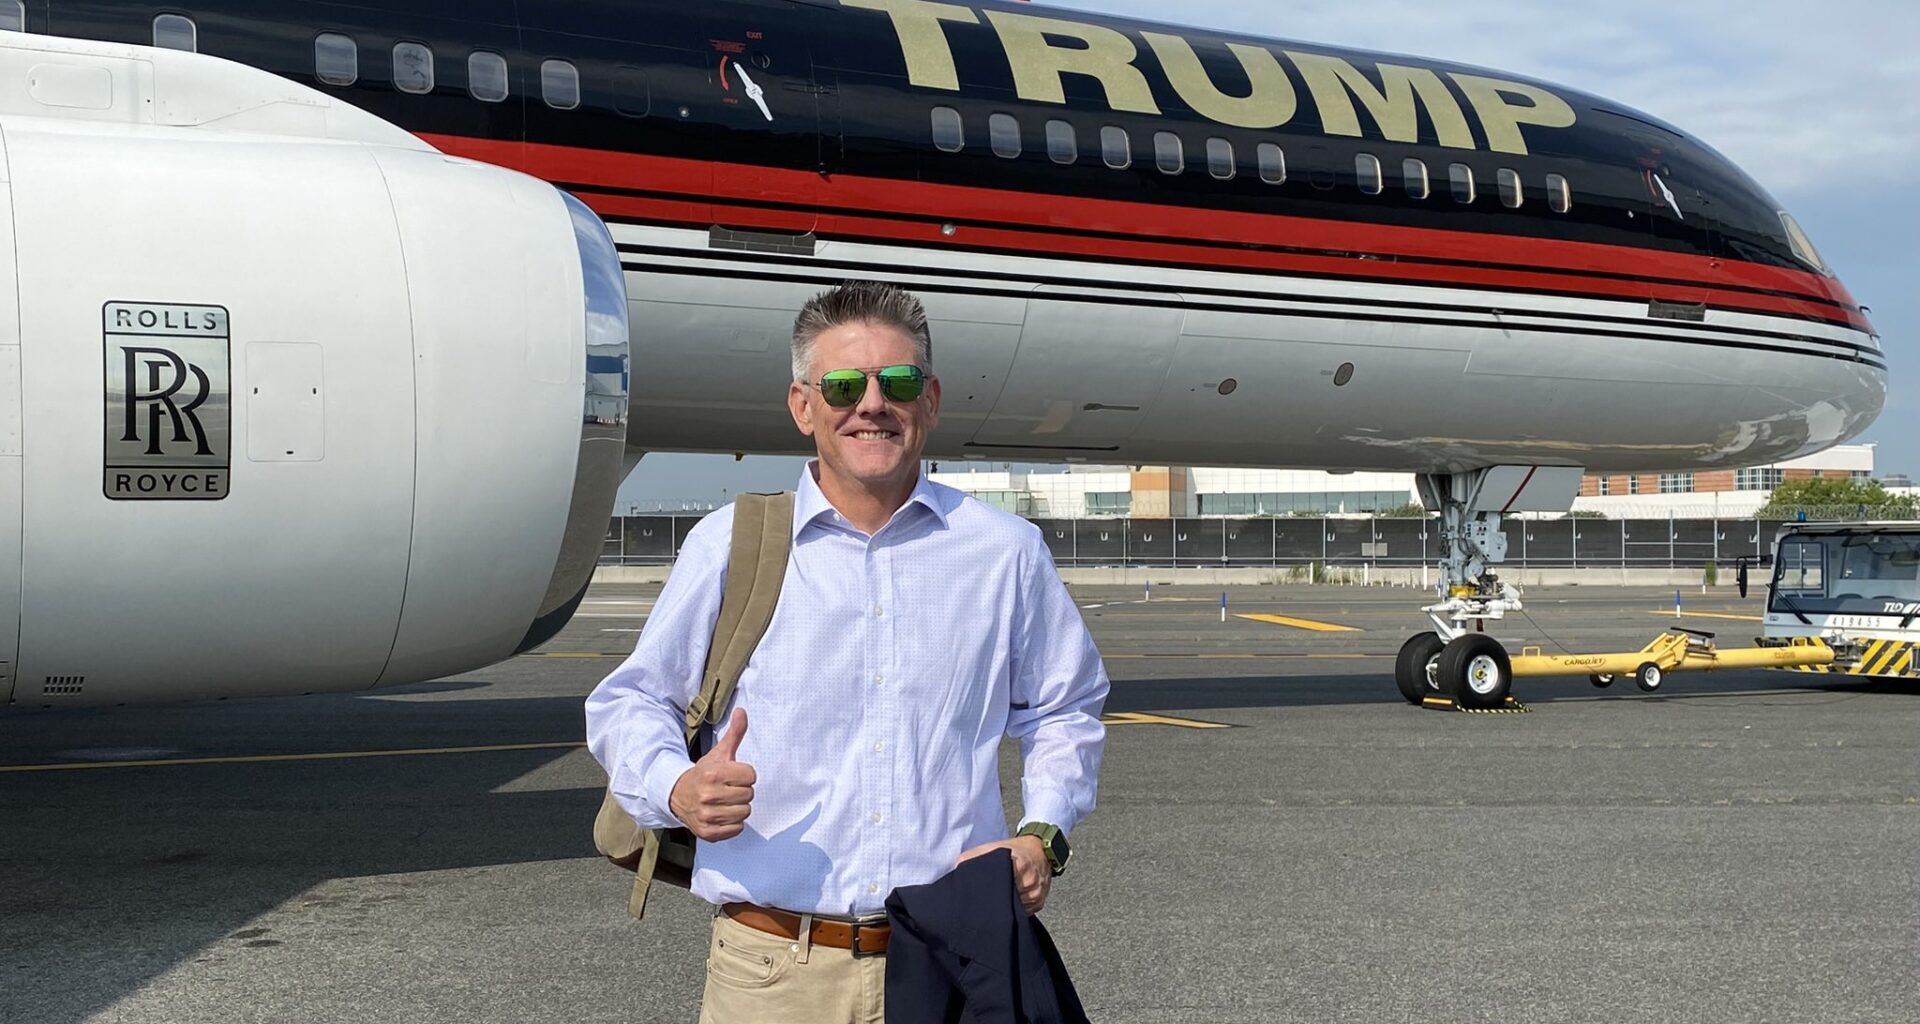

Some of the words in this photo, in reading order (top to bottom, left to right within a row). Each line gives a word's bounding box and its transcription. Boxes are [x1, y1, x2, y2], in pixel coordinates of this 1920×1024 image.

[746, 31, 763, 39] EXIT
[839, 0, 1577, 155] TRUMP
[116, 309, 217, 330] ROLLS
[120, 346, 215, 456] RR
[116, 474, 219, 492] ROYCE
[1883, 602, 1904, 612] TLD
